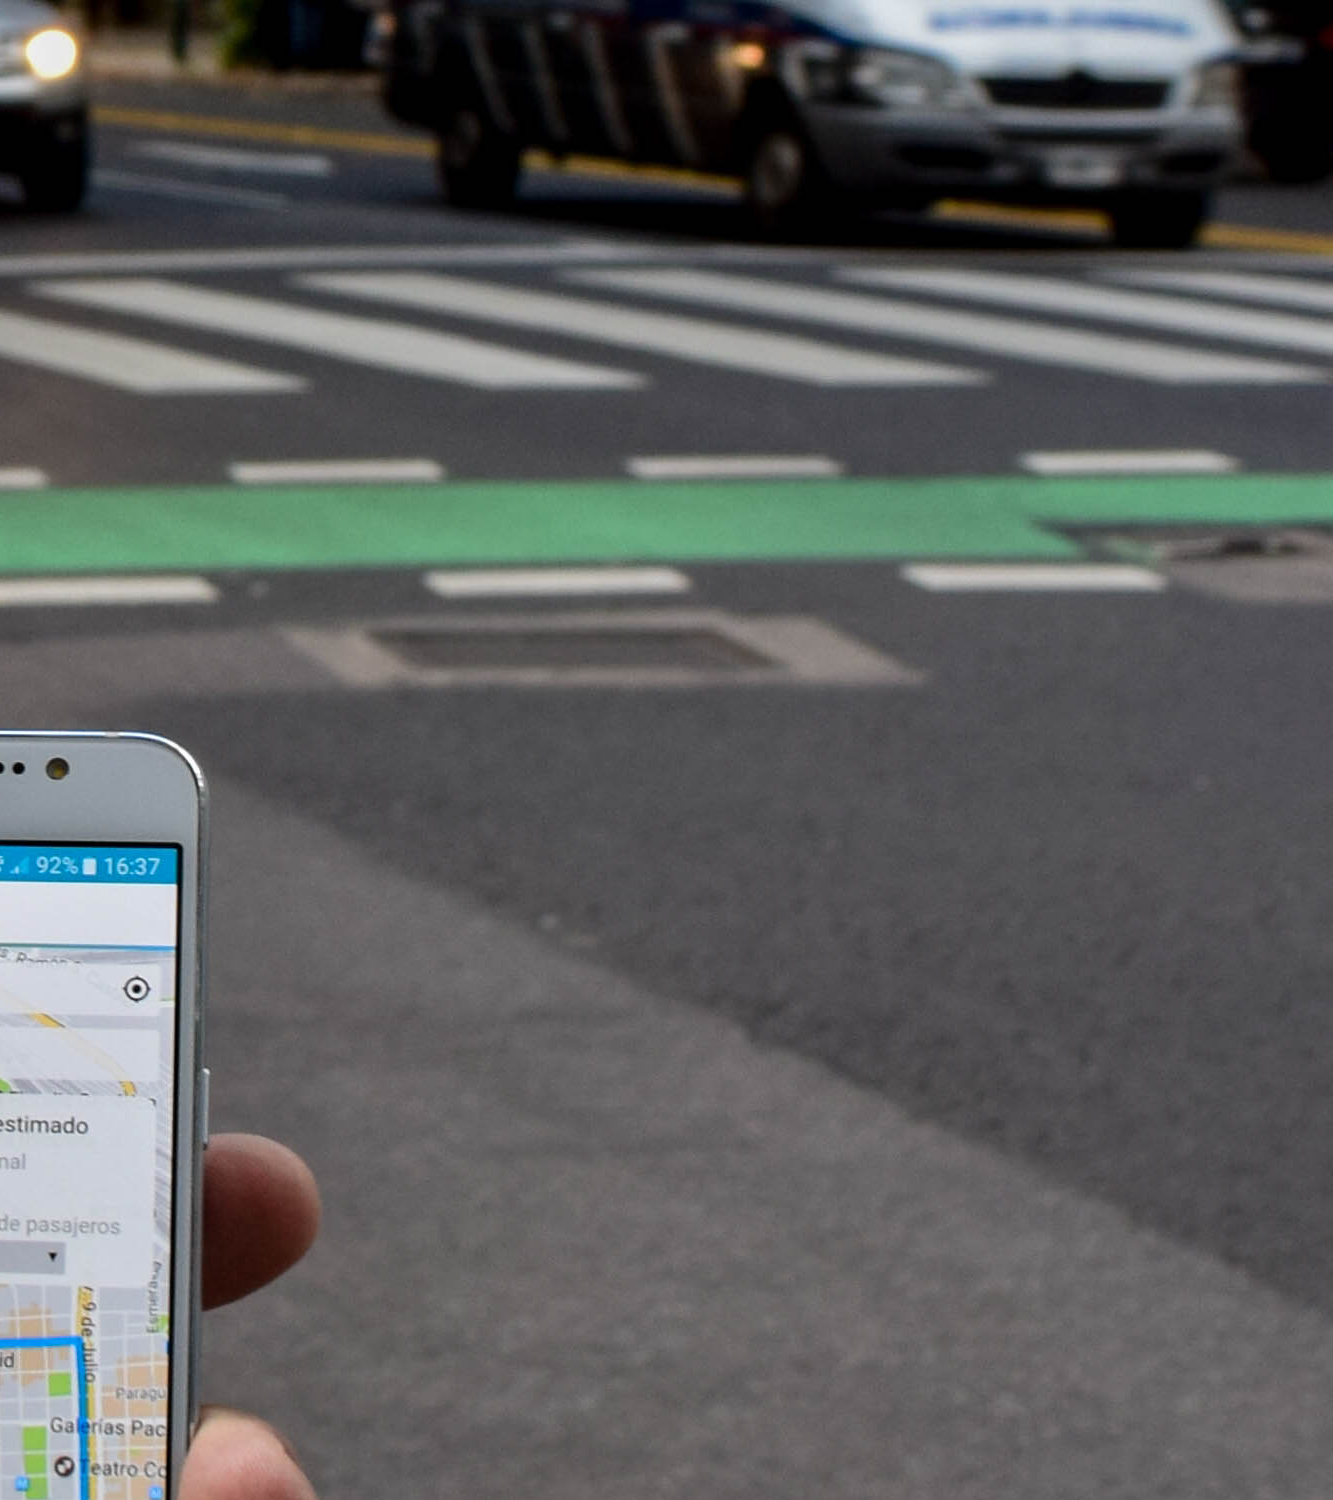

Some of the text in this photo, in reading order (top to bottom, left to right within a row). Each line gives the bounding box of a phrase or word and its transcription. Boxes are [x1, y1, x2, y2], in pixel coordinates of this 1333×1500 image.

[36, 856, 78, 874] 92%
[104, 857, 160, 875] 16:37
[26, 1217, 121, 1239] pasajeros
